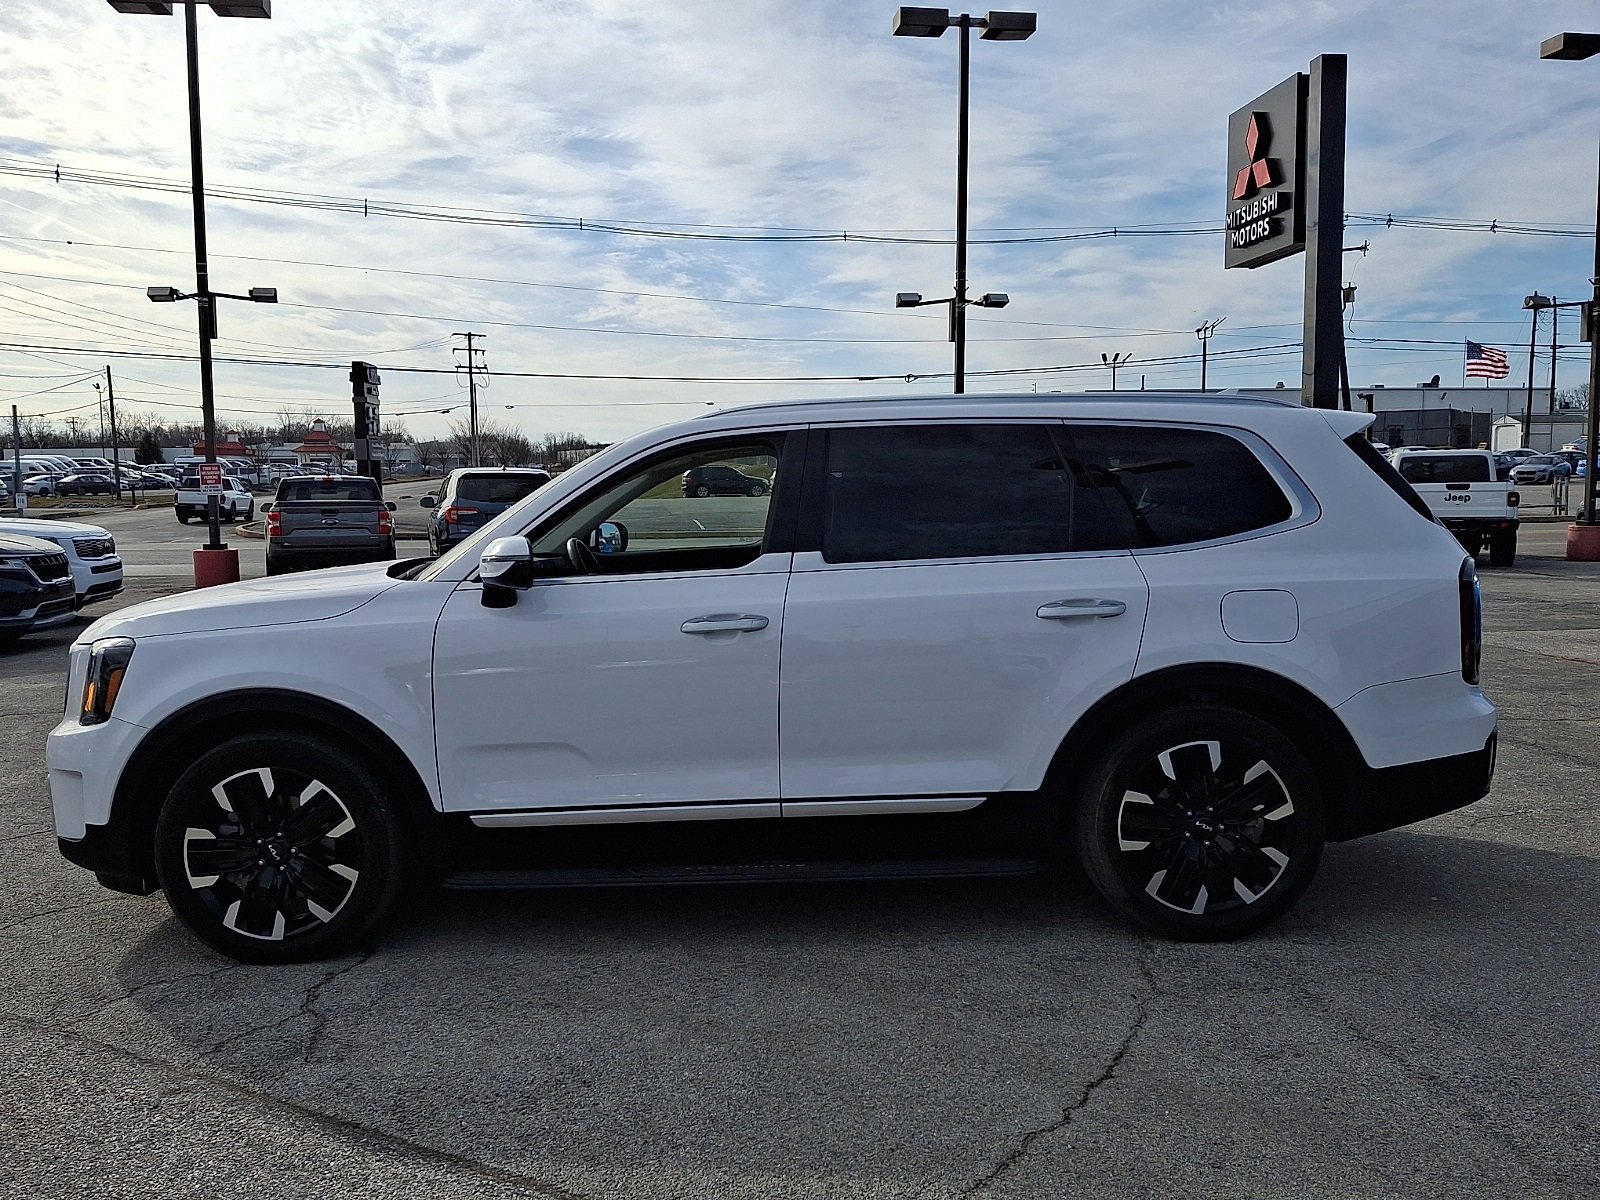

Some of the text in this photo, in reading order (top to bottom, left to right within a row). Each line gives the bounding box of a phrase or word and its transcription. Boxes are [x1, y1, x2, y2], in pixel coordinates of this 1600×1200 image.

[1226, 191, 1278, 229] MITSUBISHI
[1231, 217, 1270, 248] MOTORS
[1444, 492, 1471, 503] Jeep
